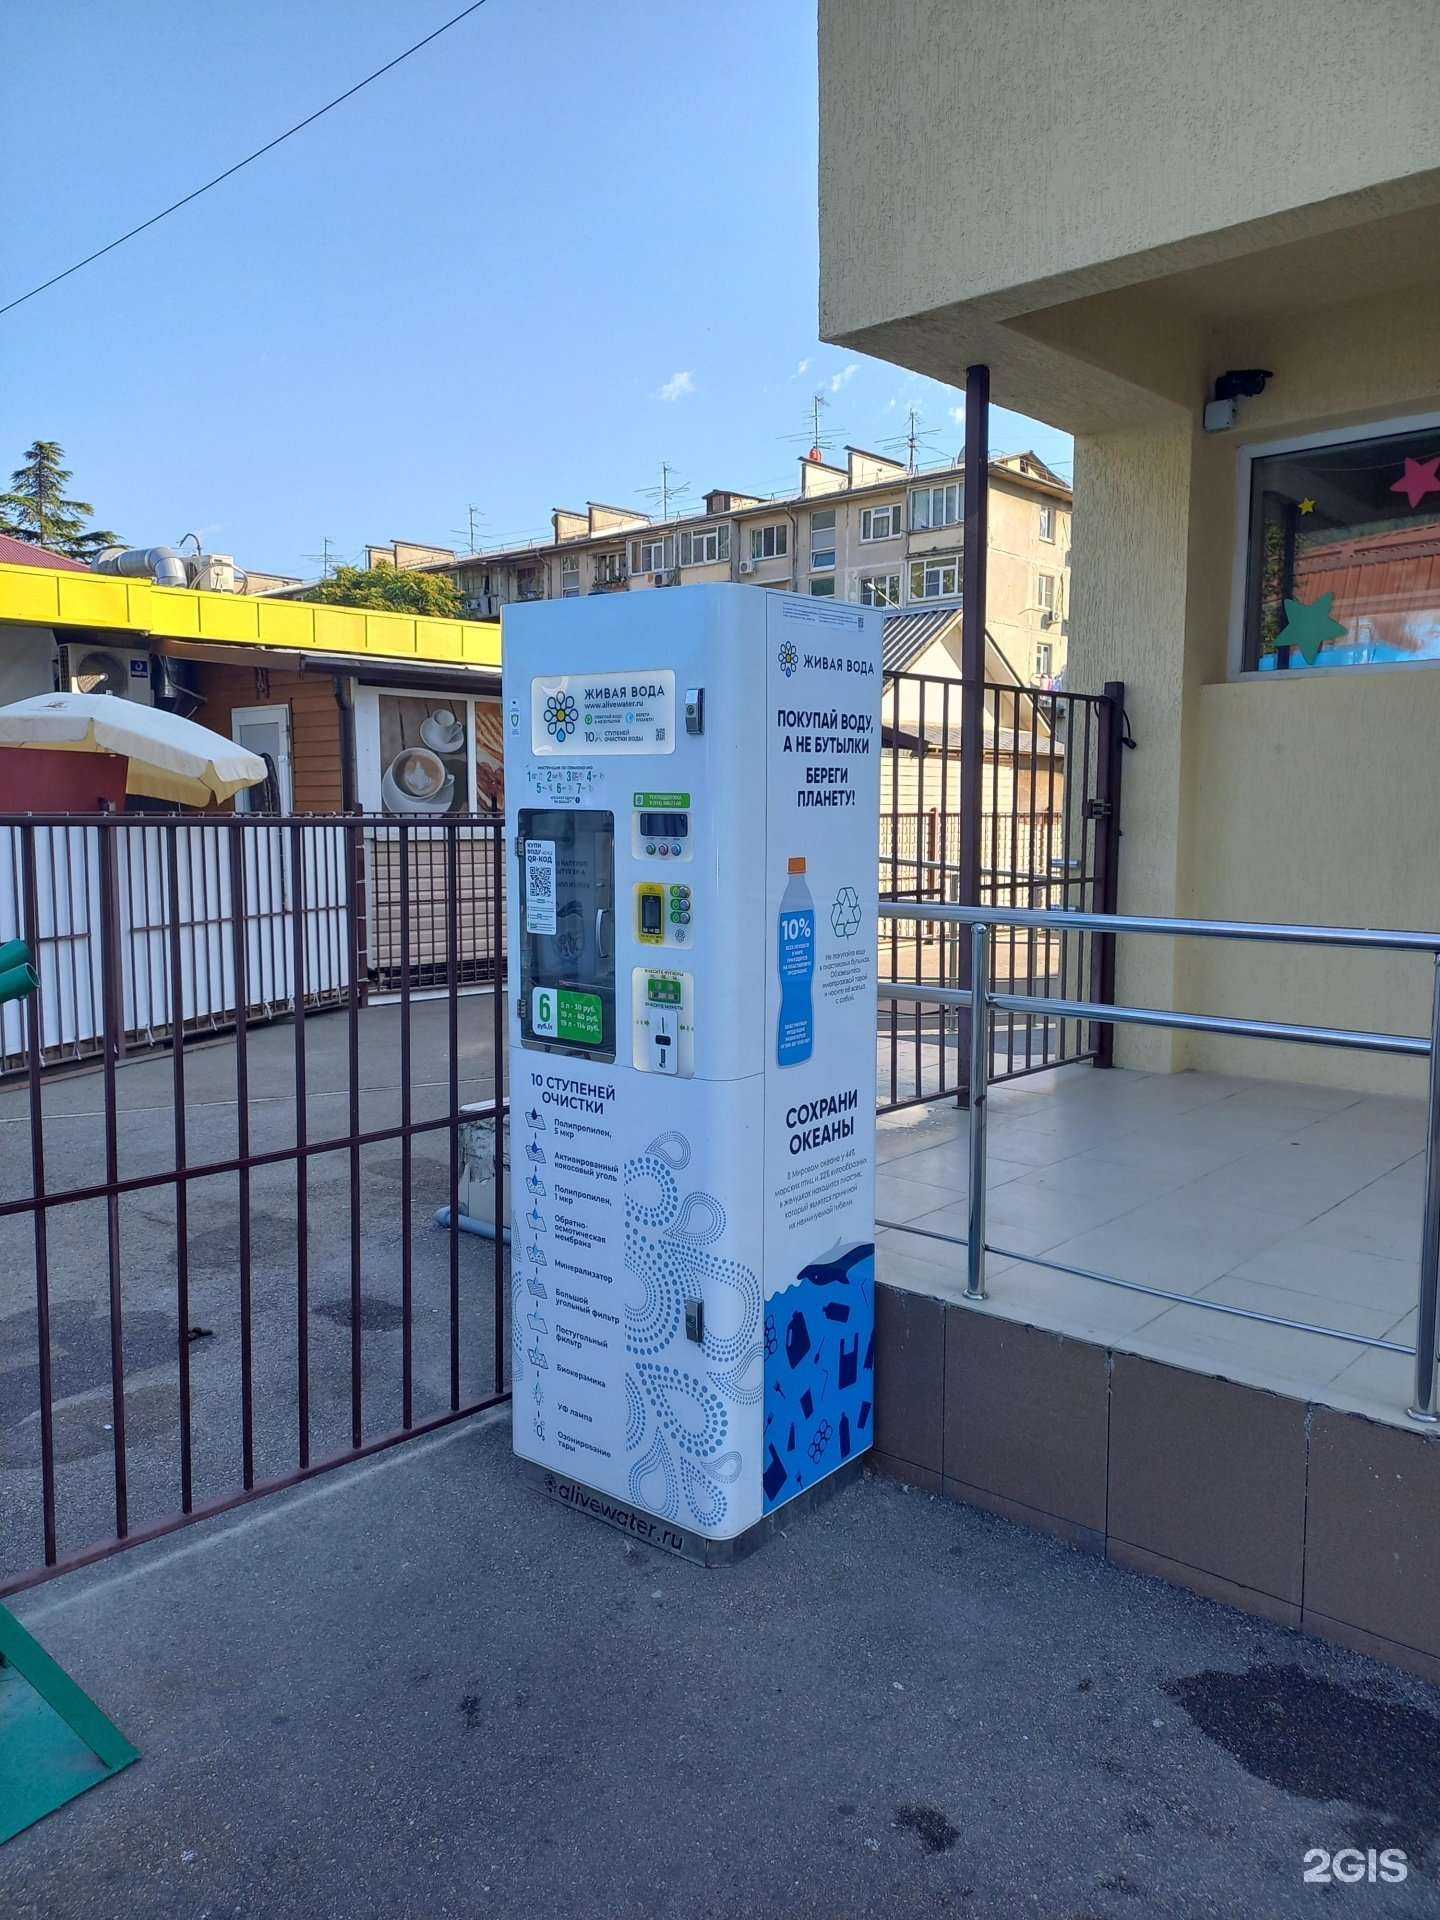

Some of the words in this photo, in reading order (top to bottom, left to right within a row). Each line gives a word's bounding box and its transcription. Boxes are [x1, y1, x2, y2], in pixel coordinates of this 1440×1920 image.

[803, 654, 843, 671] ЖИВАЯ
[846, 660, 875, 676] ВОДА
[584, 687, 627, 700] ЖИВАЯ
[631, 685, 665, 698] ВОДА
[584, 700, 644, 709] www.alivewater.ru
[777, 708, 838, 729] ПОКУПАЙ
[841, 713, 874, 734] ВОДУ,
[584, 731, 595, 742] 10
[783, 735, 793, 752] А
[796, 736, 811, 752] НЕ
[815, 736, 869, 754] БУТЫЛКИ
[527, 771, 532, 782] 1
[547, 771, 552, 782] 2
[566, 771, 571, 782] 3
[586, 771, 592, 782] 4
[806, 767, 848, 784] БЕРЕГИ
[536, 783, 541, 793] 5
[556, 783, 562, 793] 6
[576, 783, 581, 794] 7
[797, 790, 855, 807] ПЛАНЕТУ!
[528, 855, 552, 863] QR-КОД
[782, 918, 811, 940] 10%
[539, 993, 551, 1022] 6
[530, 1073, 543, 1087] 10
[546, 1076, 616, 1101] СТУПЕНЕЙ
[542, 1091, 604, 1115] ОЧИСТКИ
[786, 1088, 858, 1129] СОХРАНИ
[554, 1118, 612, 1139] Полипропилен,
[560, 1131, 575, 1139] мкр
[789, 1116, 854, 1155] ОКЕАНЫ
[554, 1152, 619, 1174] Активированный
[554, 1161, 594, 1177] кокосовый
[595, 1171, 618, 1182] уголь
[554, 1184, 612, 1207] Полипропилен,
[554, 1193, 558, 1201] 1
[559, 1195, 574, 1205] мкр
[554, 1214, 588, 1229] Обратно-
[554, 1225, 607, 1244] осмотическая
[554, 1233, 592, 1249] мембрана
[554, 1259, 613, 1284] Минерализатор
[555, 1288, 589, 1305] Большой
[555, 1297, 590, 1314] угольный
[591, 1310, 620, 1325] фильтр
[555, 1324, 608, 1348] Постугольный
[555, 1334, 582, 1349] фильтр
[556, 1363, 606, 1388] Биокерамика
[557, 1402, 569, 1413] УФ
[569, 1408, 593, 1423] лампа
[557, 1431, 611, 1458] Озонирование
[557, 1440, 576, 1453] тары
[558, 1483, 684, 1551] alivewater.ru
